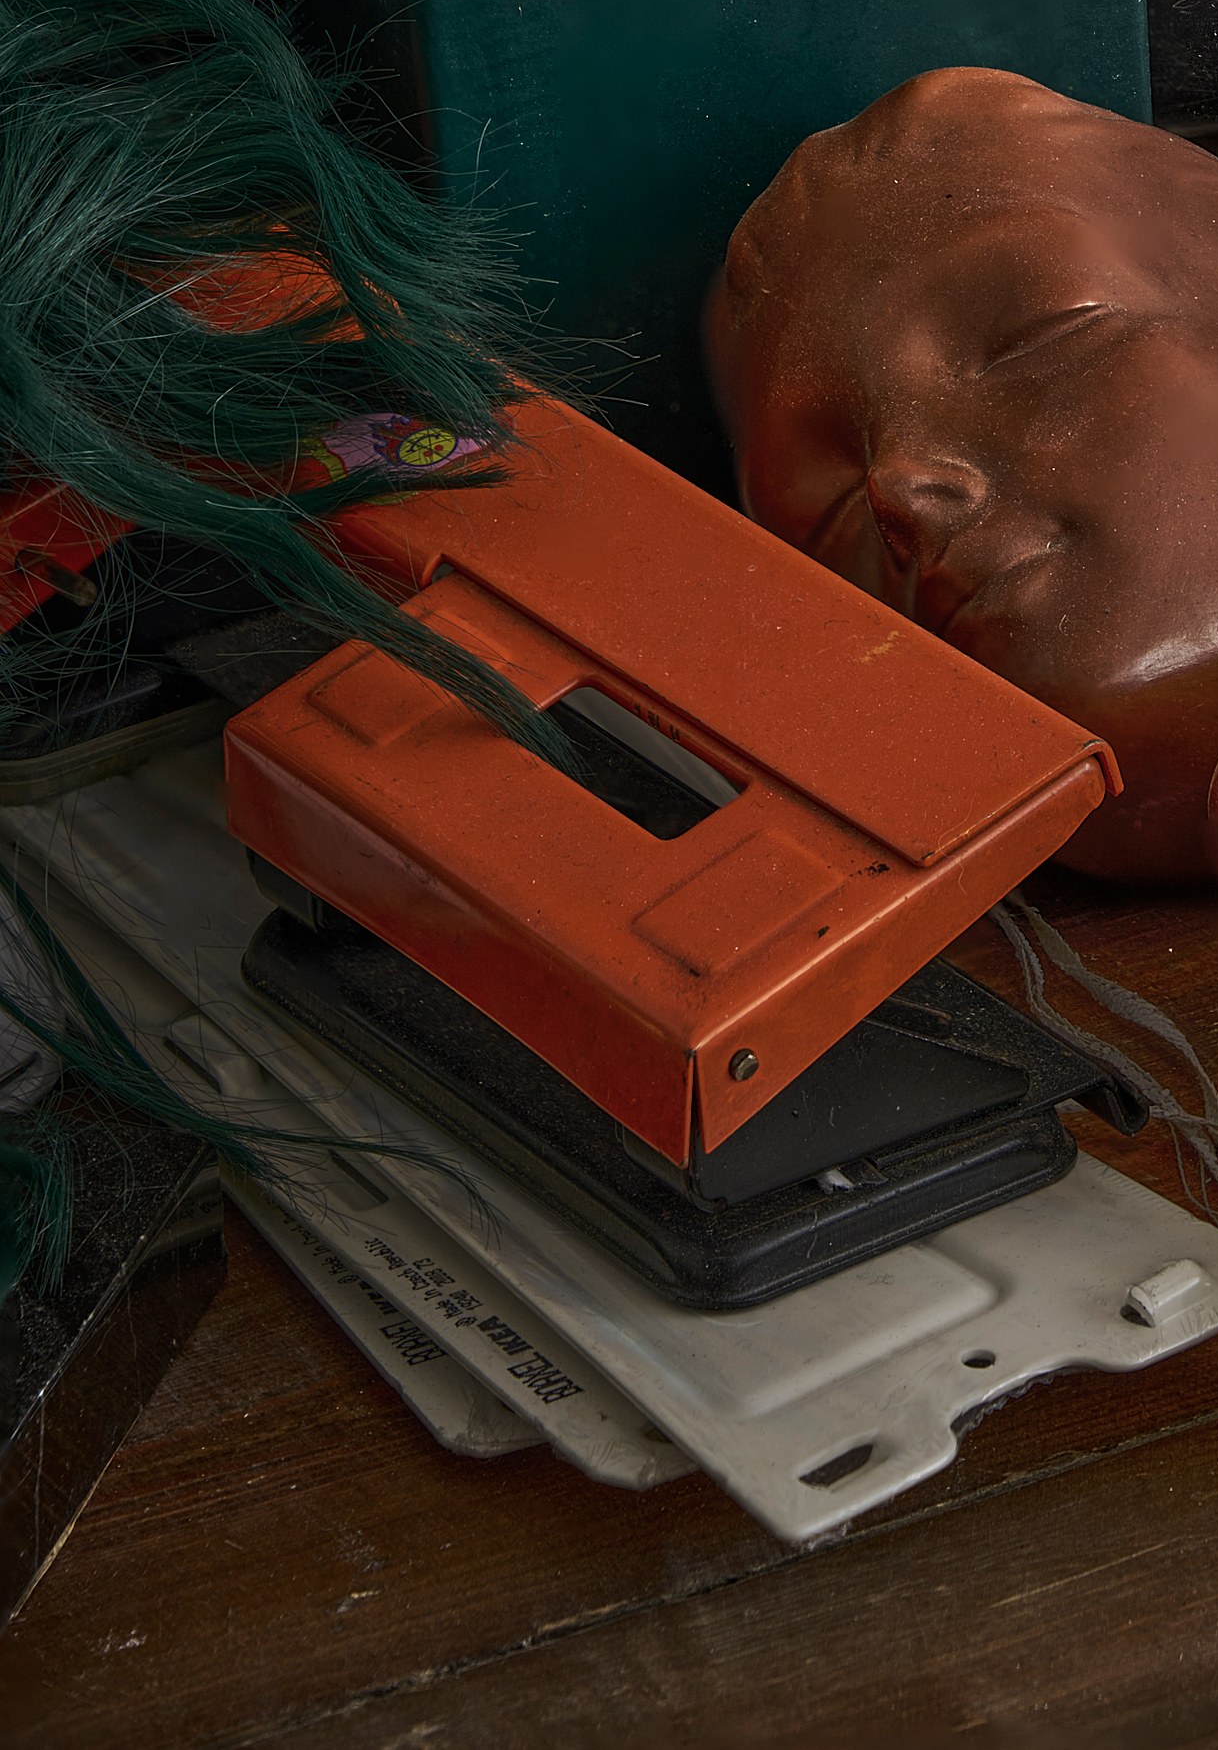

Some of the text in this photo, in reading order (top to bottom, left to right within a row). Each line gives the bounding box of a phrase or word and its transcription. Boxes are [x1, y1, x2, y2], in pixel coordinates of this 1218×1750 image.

[365, 1237, 408, 1271] Republic
[398, 1268, 431, 1291] Czech
[424, 1289, 443, 1301] In
[435, 1299, 464, 1319] Made
